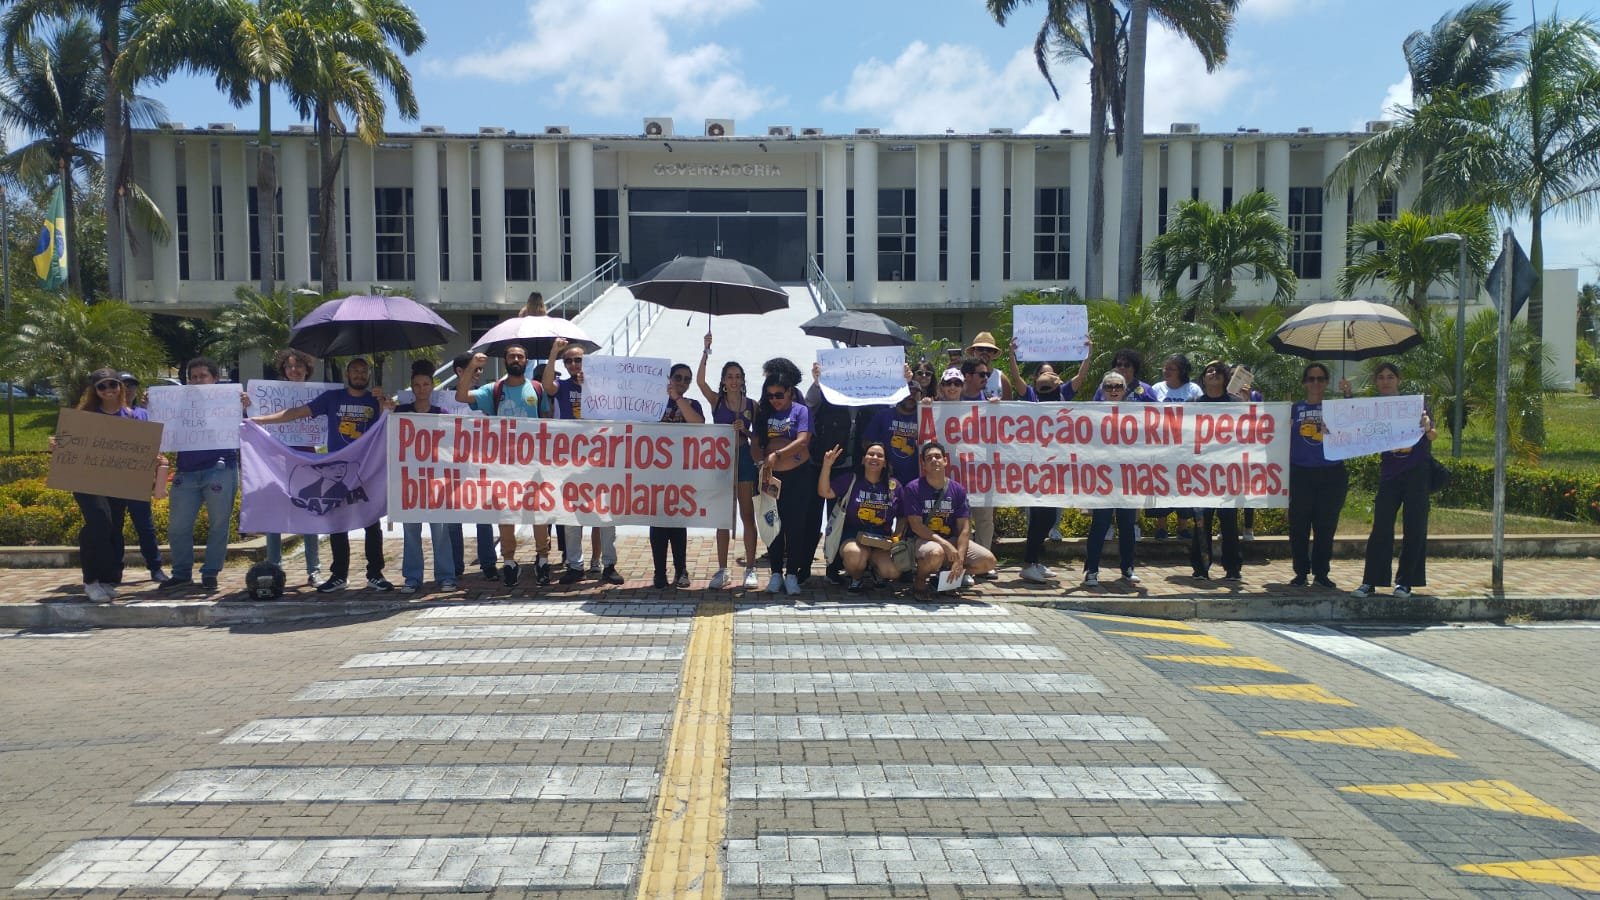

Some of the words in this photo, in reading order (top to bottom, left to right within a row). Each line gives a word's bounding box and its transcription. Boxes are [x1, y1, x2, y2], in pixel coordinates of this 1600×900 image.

[653, 162, 782, 177] GOVERNADORIA
[398, 418, 446, 464] Por
[453, 418, 673, 469] bibliotecários
[682, 435, 731, 470] nas
[918, 407, 938, 445] A
[944, 405, 1092, 449] educação
[1100, 405, 1139, 445] do
[1144, 406, 1184, 445] RN
[1194, 404, 1275, 454] pede
[401, 466, 557, 513] bibliotecas
[562, 473, 707, 518] escolares.
[1120, 463, 1170, 496] nas
[1176, 452, 1289, 497] escolas.
